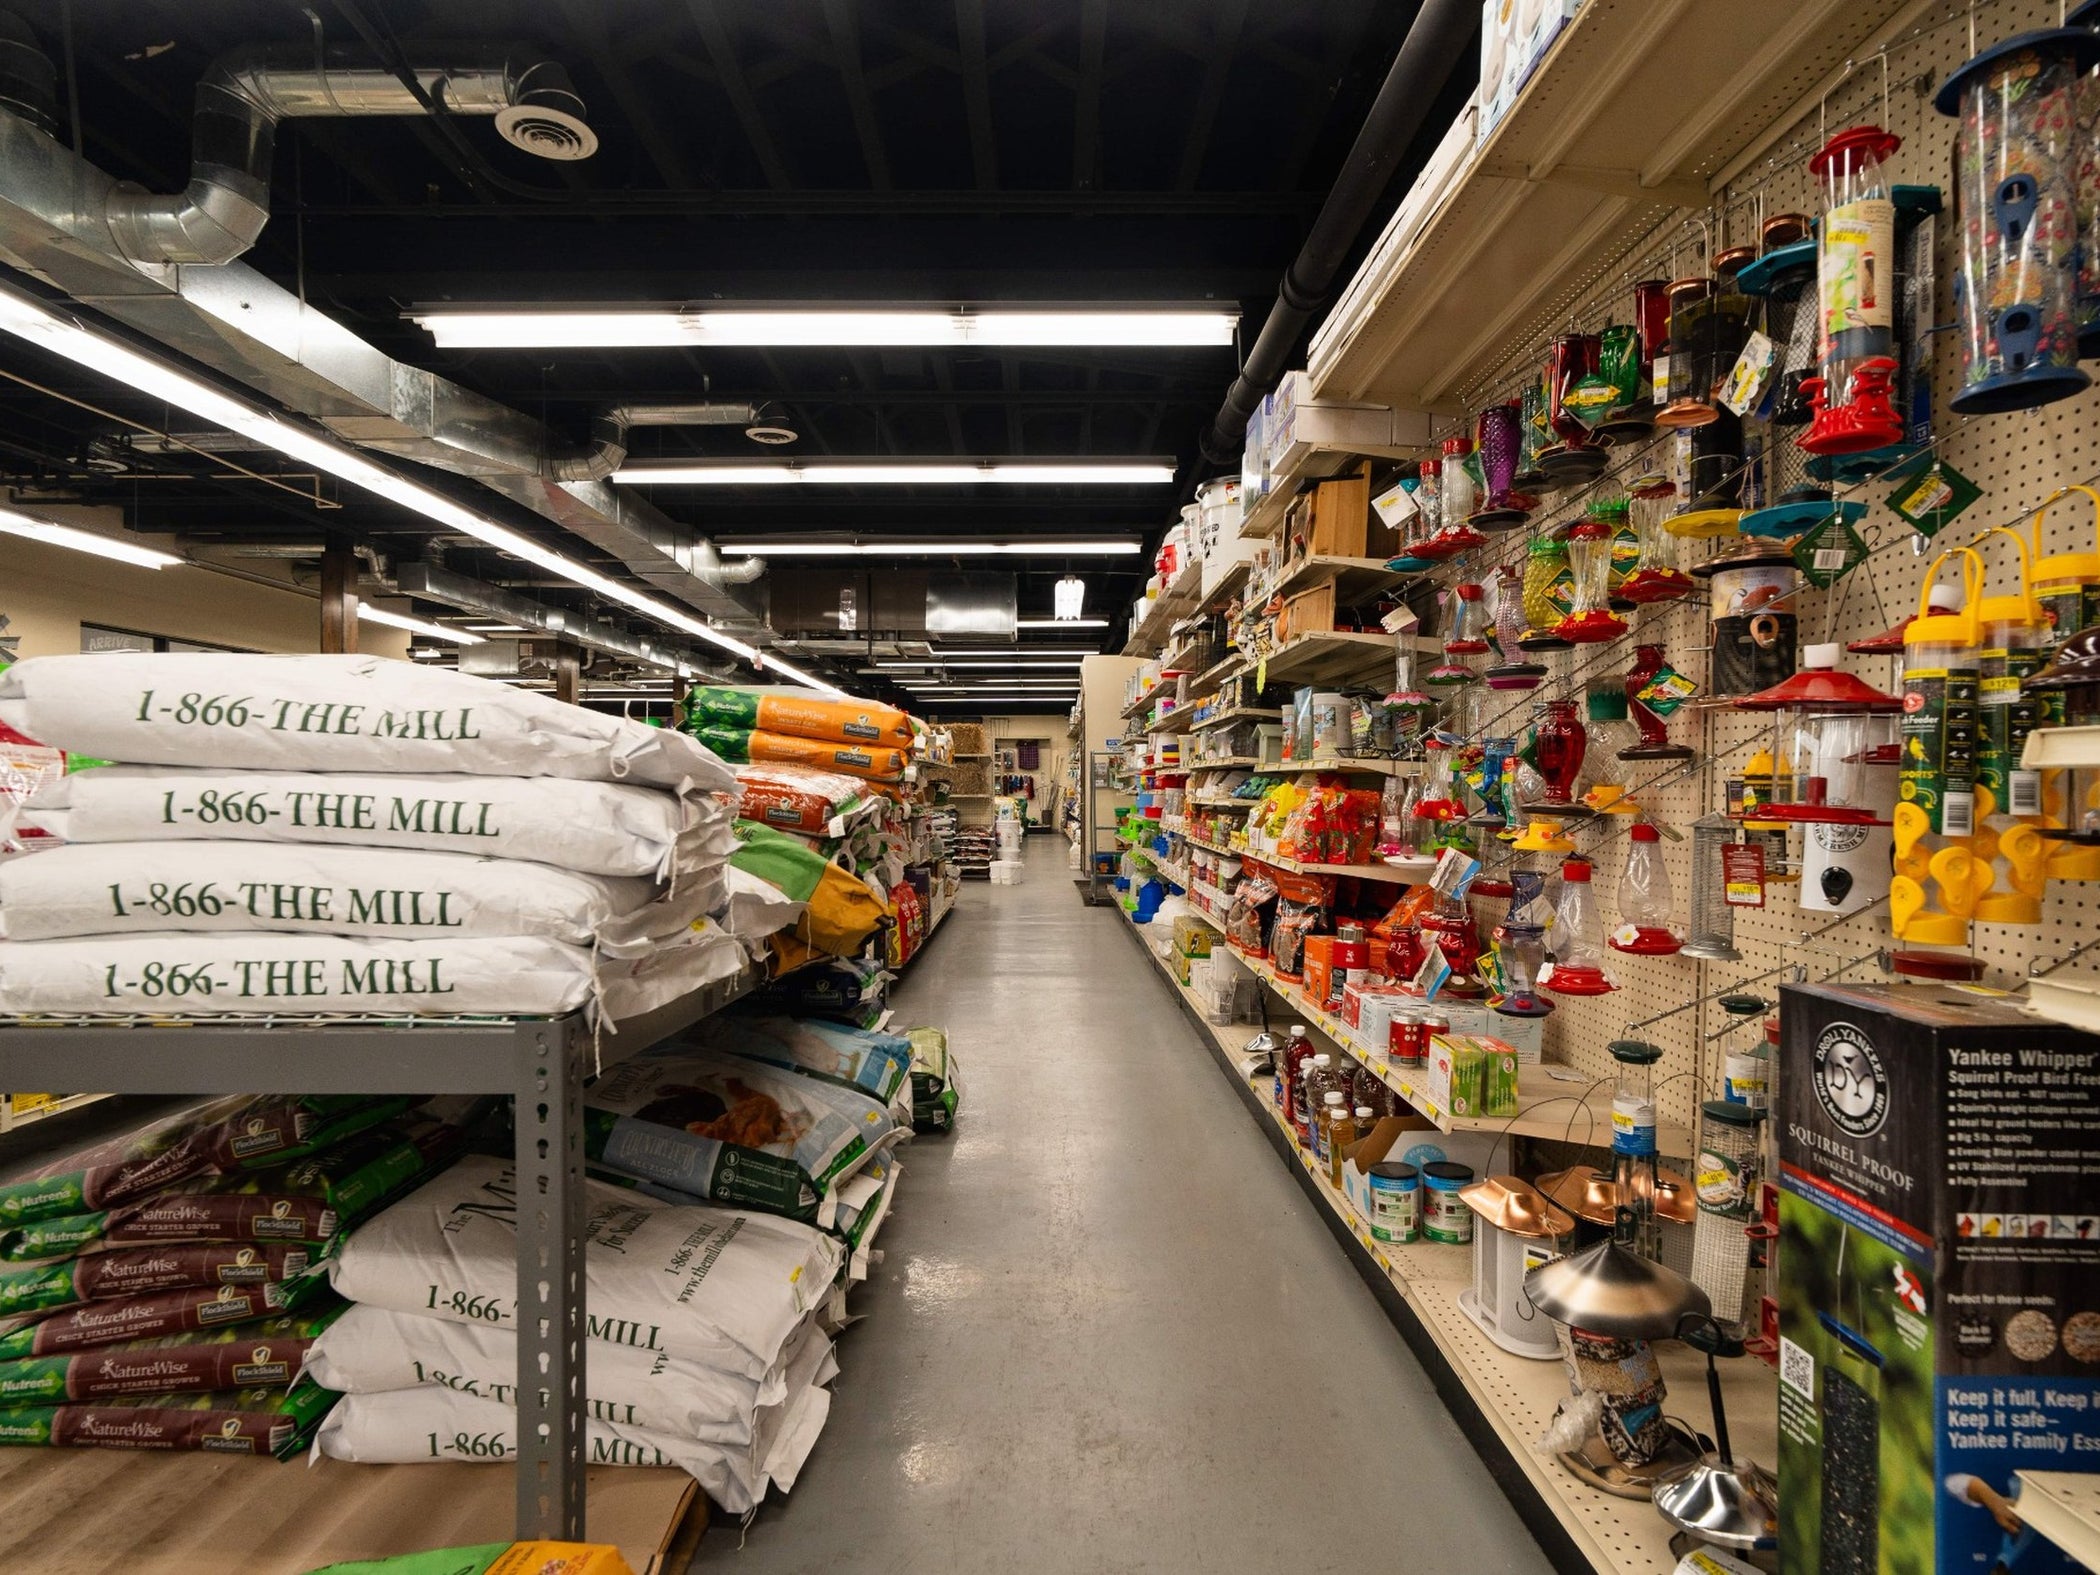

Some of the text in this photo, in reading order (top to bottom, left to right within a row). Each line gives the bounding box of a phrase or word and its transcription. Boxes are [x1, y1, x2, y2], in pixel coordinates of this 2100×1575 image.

[88, 636, 132, 650] ARRIVE
[136, 689, 482, 741] 1-866-THE MILL
[162, 789, 501, 837] 1-866-THE MILL
[107, 881, 464, 928] 1-866-THE MILL
[104, 957, 455, 998] 1-866-THE MILL
[1815, 1029, 1842, 1062] DROLL
[1948, 1048, 2093, 1071] Yankee Whipper
[1948, 1070, 2001, 1085] Squirrel
[2003, 1071, 2039, 1085] Proof
[2041, 1072, 2070, 1085] Bird
[1980, 1118, 1994, 1128] for
[1788, 1123, 1859, 1166] SQUIRREL
[1861, 1154, 1915, 1192] PROOF
[21, 1189, 72, 1207] Nutrena
[440, 1214, 473, 1235] The
[103, 1259, 178, 1279] NatureWise
[73, 1307, 155, 1328] NatureWise
[426, 1284, 664, 1352] 1-866- MILL
[55, 1319, 165, 1343] CHICK STARTER GROWER
[101, 1360, 188, 1379] NatureWise
[2, 1377, 54, 1392] Nutrena
[90, 1383, 119, 1392] CHICK
[121, 1379, 157, 1388] STARTER
[1948, 1389, 1988, 1408] Keep
[1992, 1388, 2006, 1406] it
[2009, 1390, 2041, 1409] full,
[2044, 1390, 2088, 1410] Keep
[82, 1416, 163, 1437] NatureWise
[1948, 1409, 1989, 1428] Keep
[1992, 1409, 2007, 1427] it
[1948, 1431, 2008, 1449] Yankee
[2012, 1433, 2069, 1454] Family
